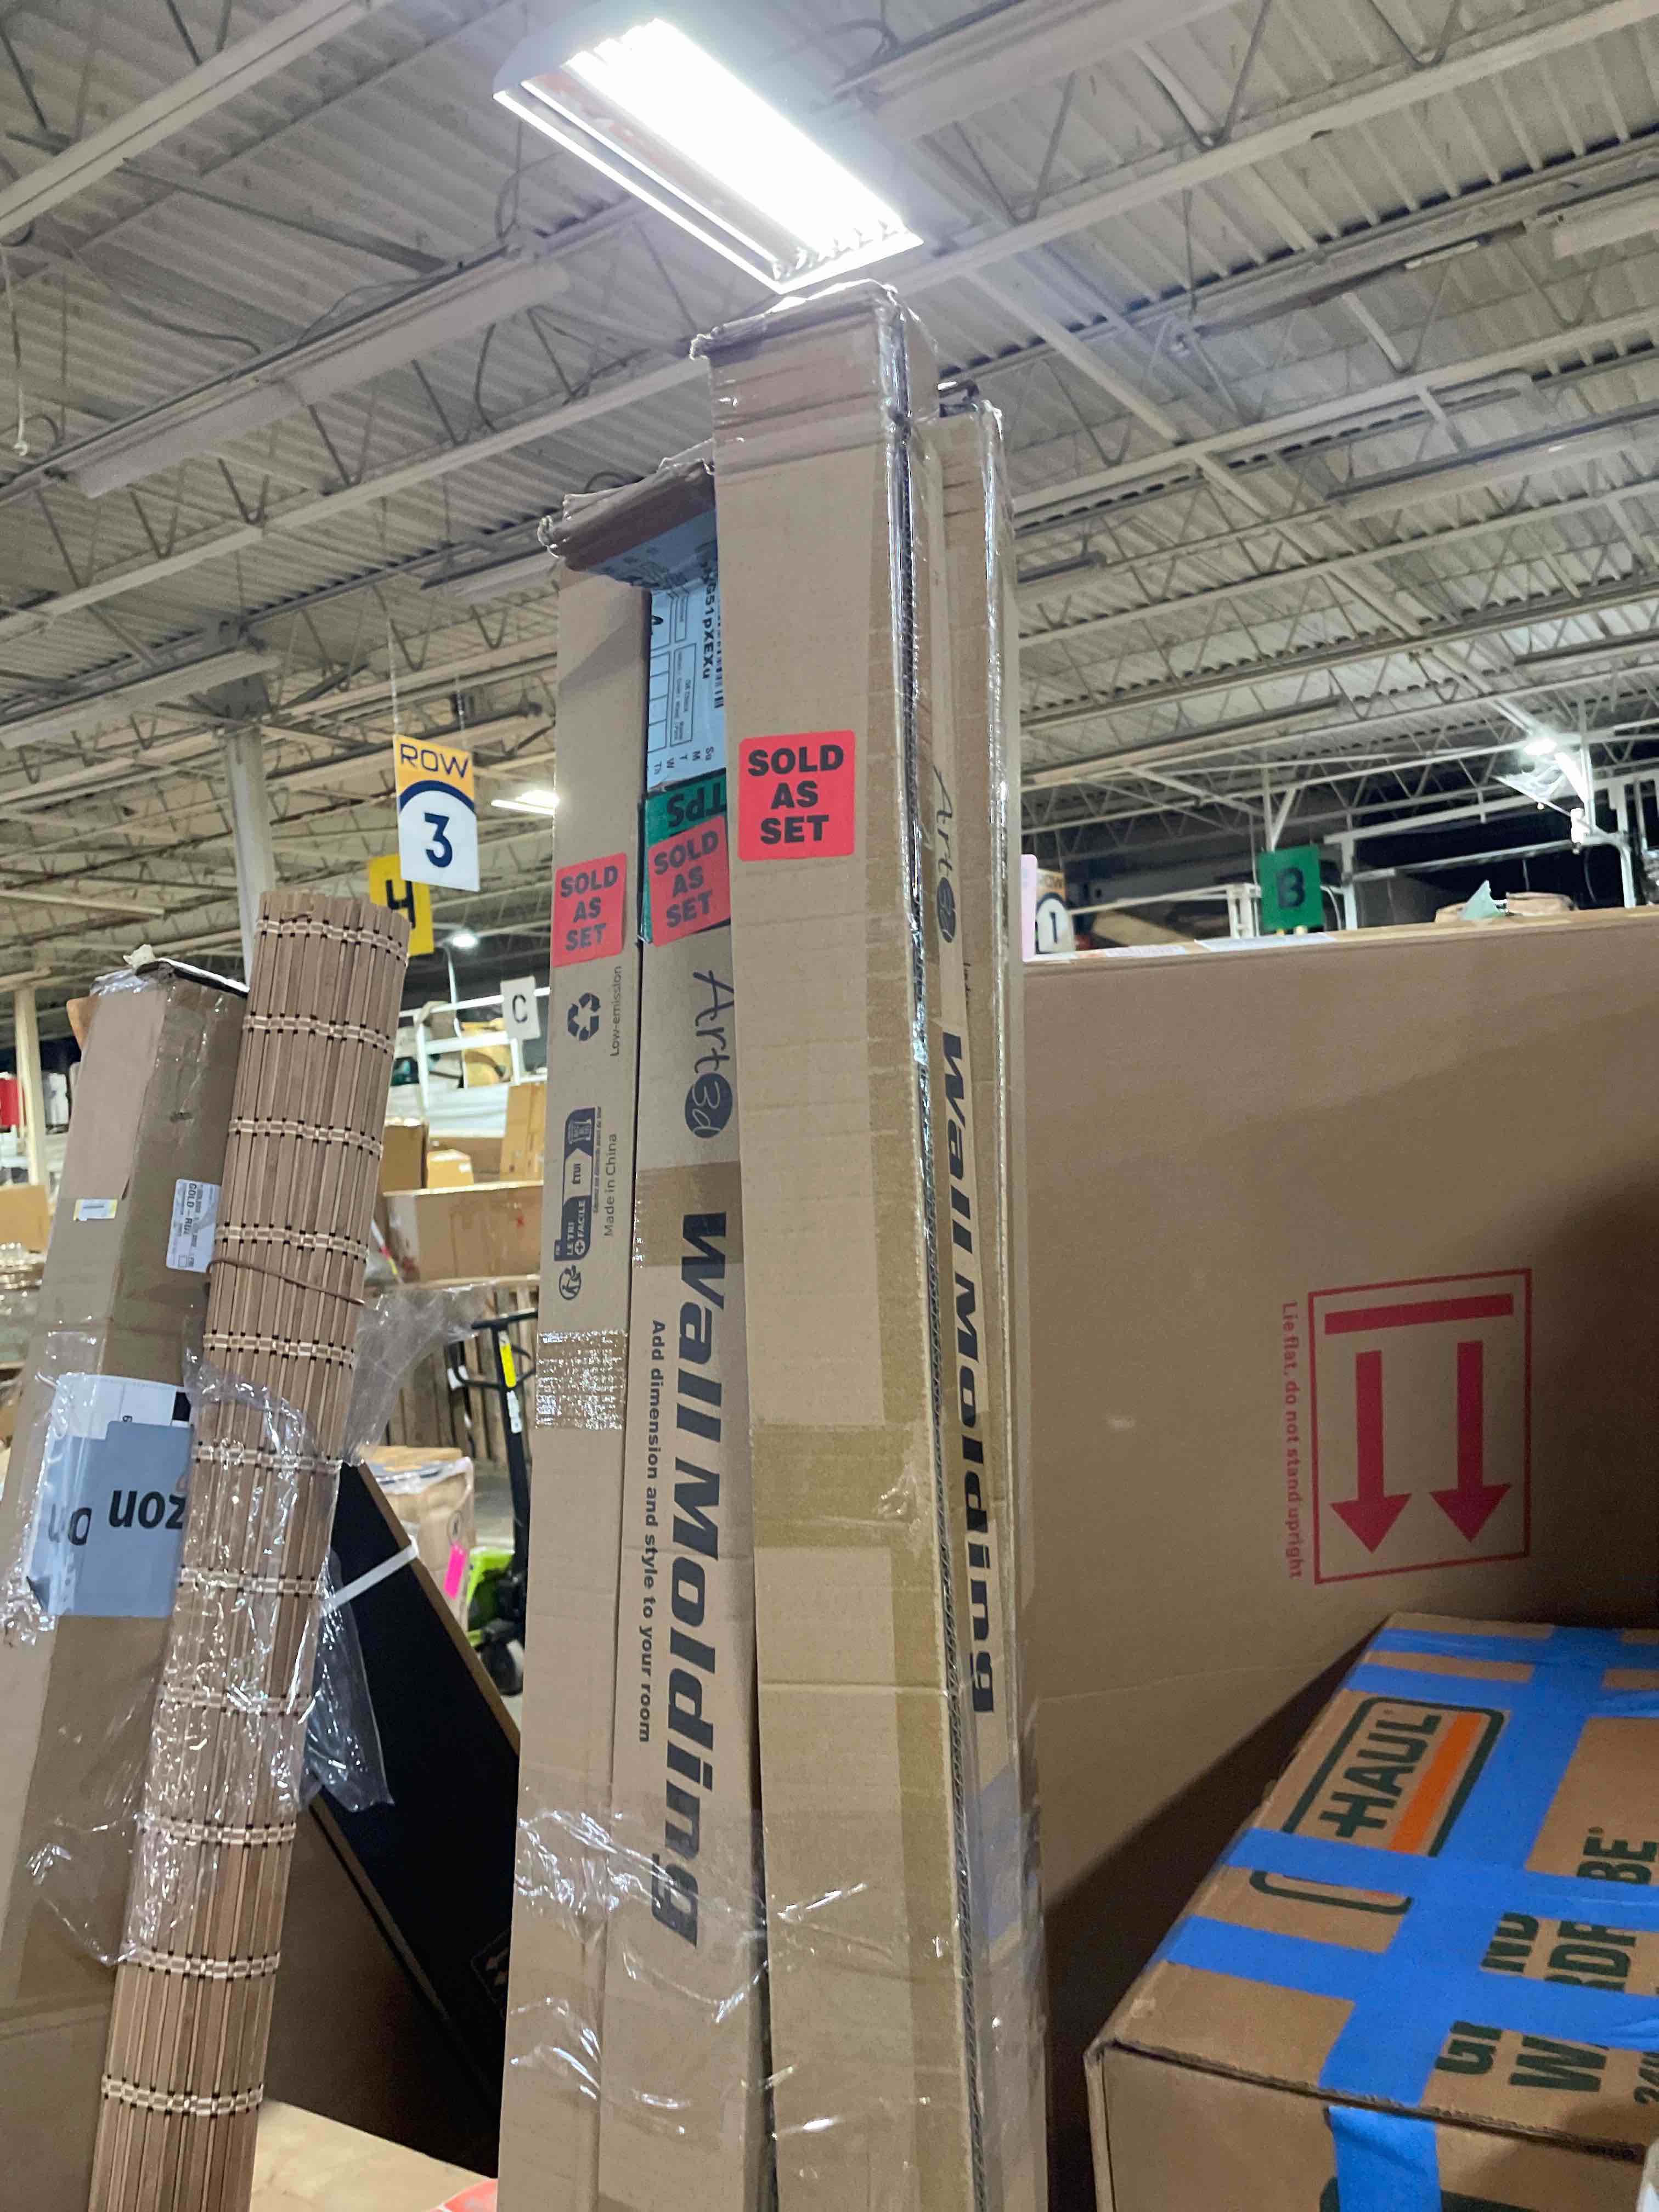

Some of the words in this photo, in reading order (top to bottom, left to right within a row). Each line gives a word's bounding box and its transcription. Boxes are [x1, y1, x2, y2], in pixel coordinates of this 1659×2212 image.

[400, 744, 469, 778] ROW
[747, 744, 844, 777] SOLD
[770, 780, 819, 811] AS
[424, 812, 453, 868] 3
[760, 814, 830, 845] SET
[654, 831, 719, 875] SOLD
[560, 865, 618, 898] SOLD
[673, 865, 704, 898] AS
[1276, 867, 1306, 908] B
[573, 896, 601, 923] AS
[666, 891, 712, 928] SET
[1049, 911, 1058, 944] 1
[565, 923, 606, 951] SET
[512, 994, 528, 1023] C
[610, 965, 623, 1057] Low-emission
[605, 1134, 617, 1176] China
[943, 1031, 973, 1255] Wall
[605, 1183, 615, 1195] in
[577, 1200, 585, 1238] FACILE
[604, 1198, 615, 1236] Made
[676, 1211, 727, 1442] Wall
[1282, 1301, 1298, 1331] Lie
[652, 1320, 665, 1361] Add
[1285, 1380, 1300, 1404] do
[647, 1367, 664, 1479] dimension
[1285, 1409, 1300, 1444] not
[955, 1271, 994, 1712] Molding
[1286, 1448, 1301, 1503] stand
[646, 1486, 659, 1527] and
[641, 1533, 658, 1590] style
[1286, 1510, 1303, 1579] upright
[642, 1597, 656, 1619] to
[639, 1626, 657, 1678] your
[639, 1684, 652, 1743] room
[651, 1456, 720, 1948] Molding
